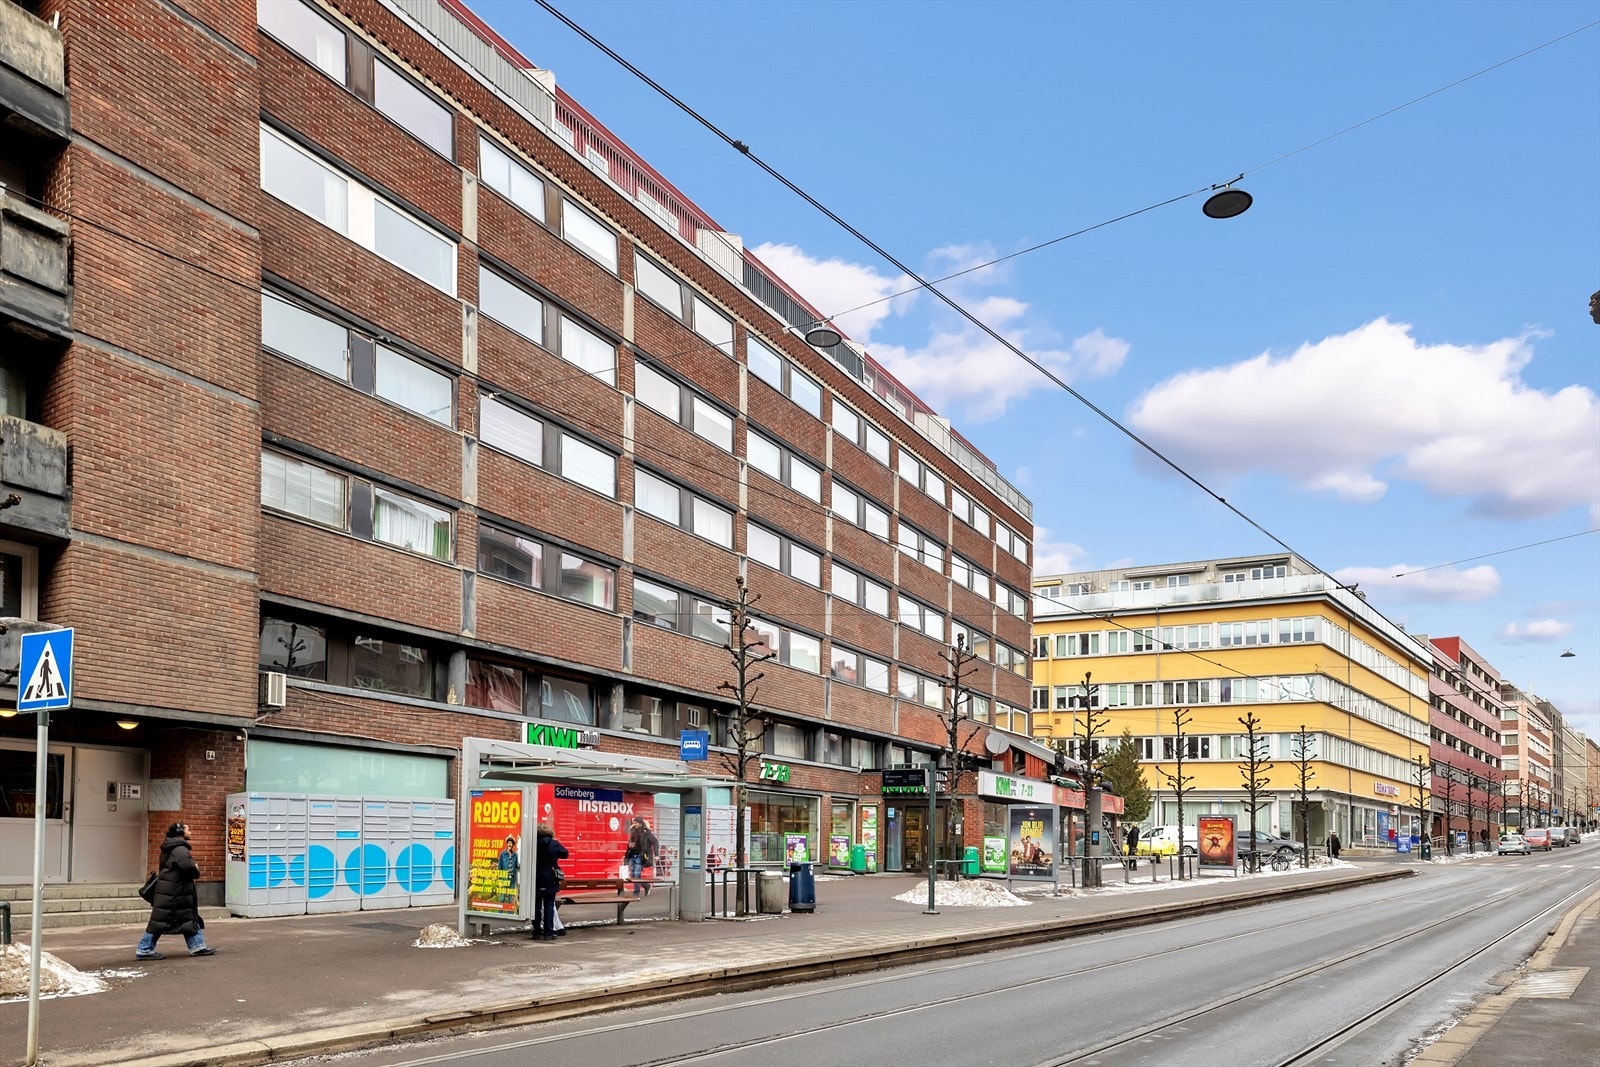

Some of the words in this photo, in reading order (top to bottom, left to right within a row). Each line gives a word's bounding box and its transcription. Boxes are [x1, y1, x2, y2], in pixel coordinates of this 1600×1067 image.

[527, 722, 578, 749] KIWI
[762, 762, 790, 781] 7-23
[555, 787, 595, 800] Sofienberg
[995, 776, 1011, 796] KIWI
[473, 801, 520, 824] RODEO
[472, 839, 491, 848] TOBIAS
[491, 839, 504, 848] STEN
